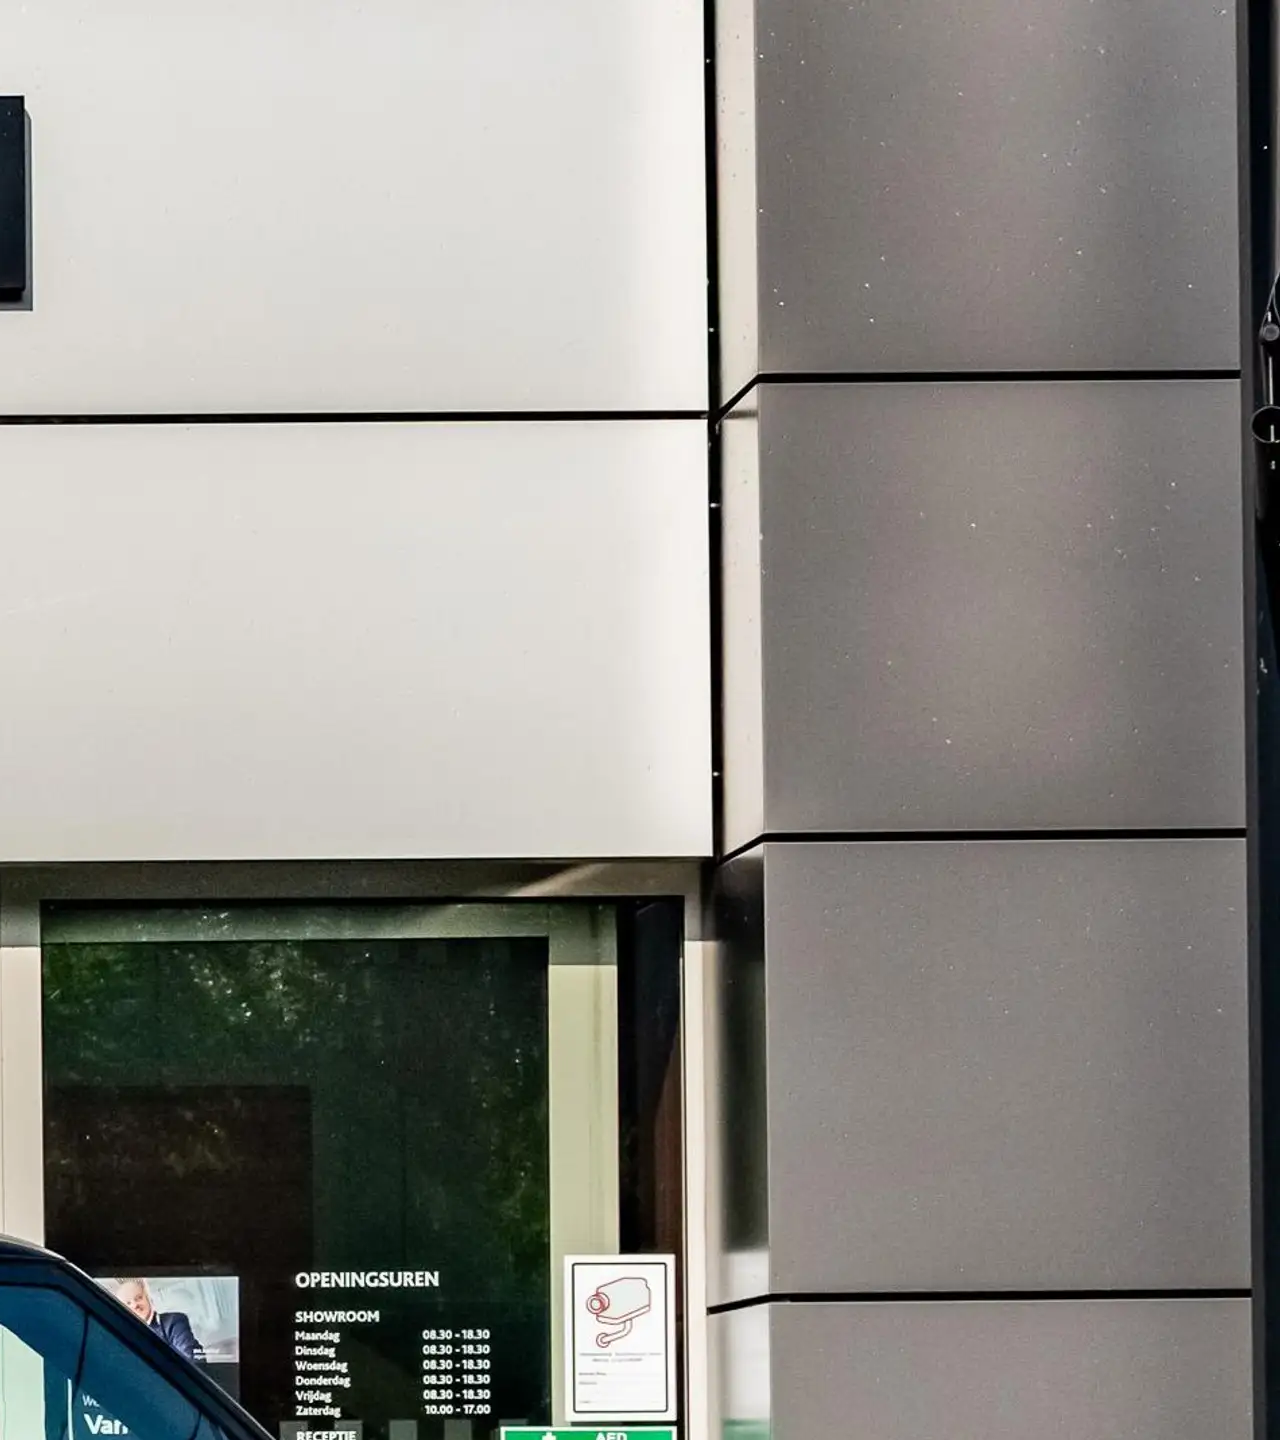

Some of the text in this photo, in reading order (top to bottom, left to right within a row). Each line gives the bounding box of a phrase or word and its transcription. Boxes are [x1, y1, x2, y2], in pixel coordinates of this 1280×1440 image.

[295, 1271, 439, 1288] OPENINGSUREN
[295, 1310, 380, 1322] SHOWROOM
[295, 1330, 340, 1343] Maandag
[422, 1330, 453, 1340] 08.30
[462, 1330, 490, 1340] 18.30
[295, 1345, 336, 1358] Dinsdag
[422, 1344, 453, 1355] 08.30
[462, 1344, 490, 1355] 18.30
[295, 1360, 348, 1373] Woensdag
[422, 1359, 453, 1370] 08.30
[462, 1359, 490, 1370] 18.30
[295, 1375, 351, 1388] Donderdag
[422, 1374, 453, 1385] 08.30
[462, 1374, 490, 1385] 18.30
[295, 1390, 332, 1403] Vrijdag
[422, 1389, 453, 1399] 08.30
[462, 1389, 490, 1399] 18.30
[295, 1405, 341, 1418] Zaterdag
[425, 1404, 453, 1415] 10.00
[462, 1404, 490, 1415] 17.00
